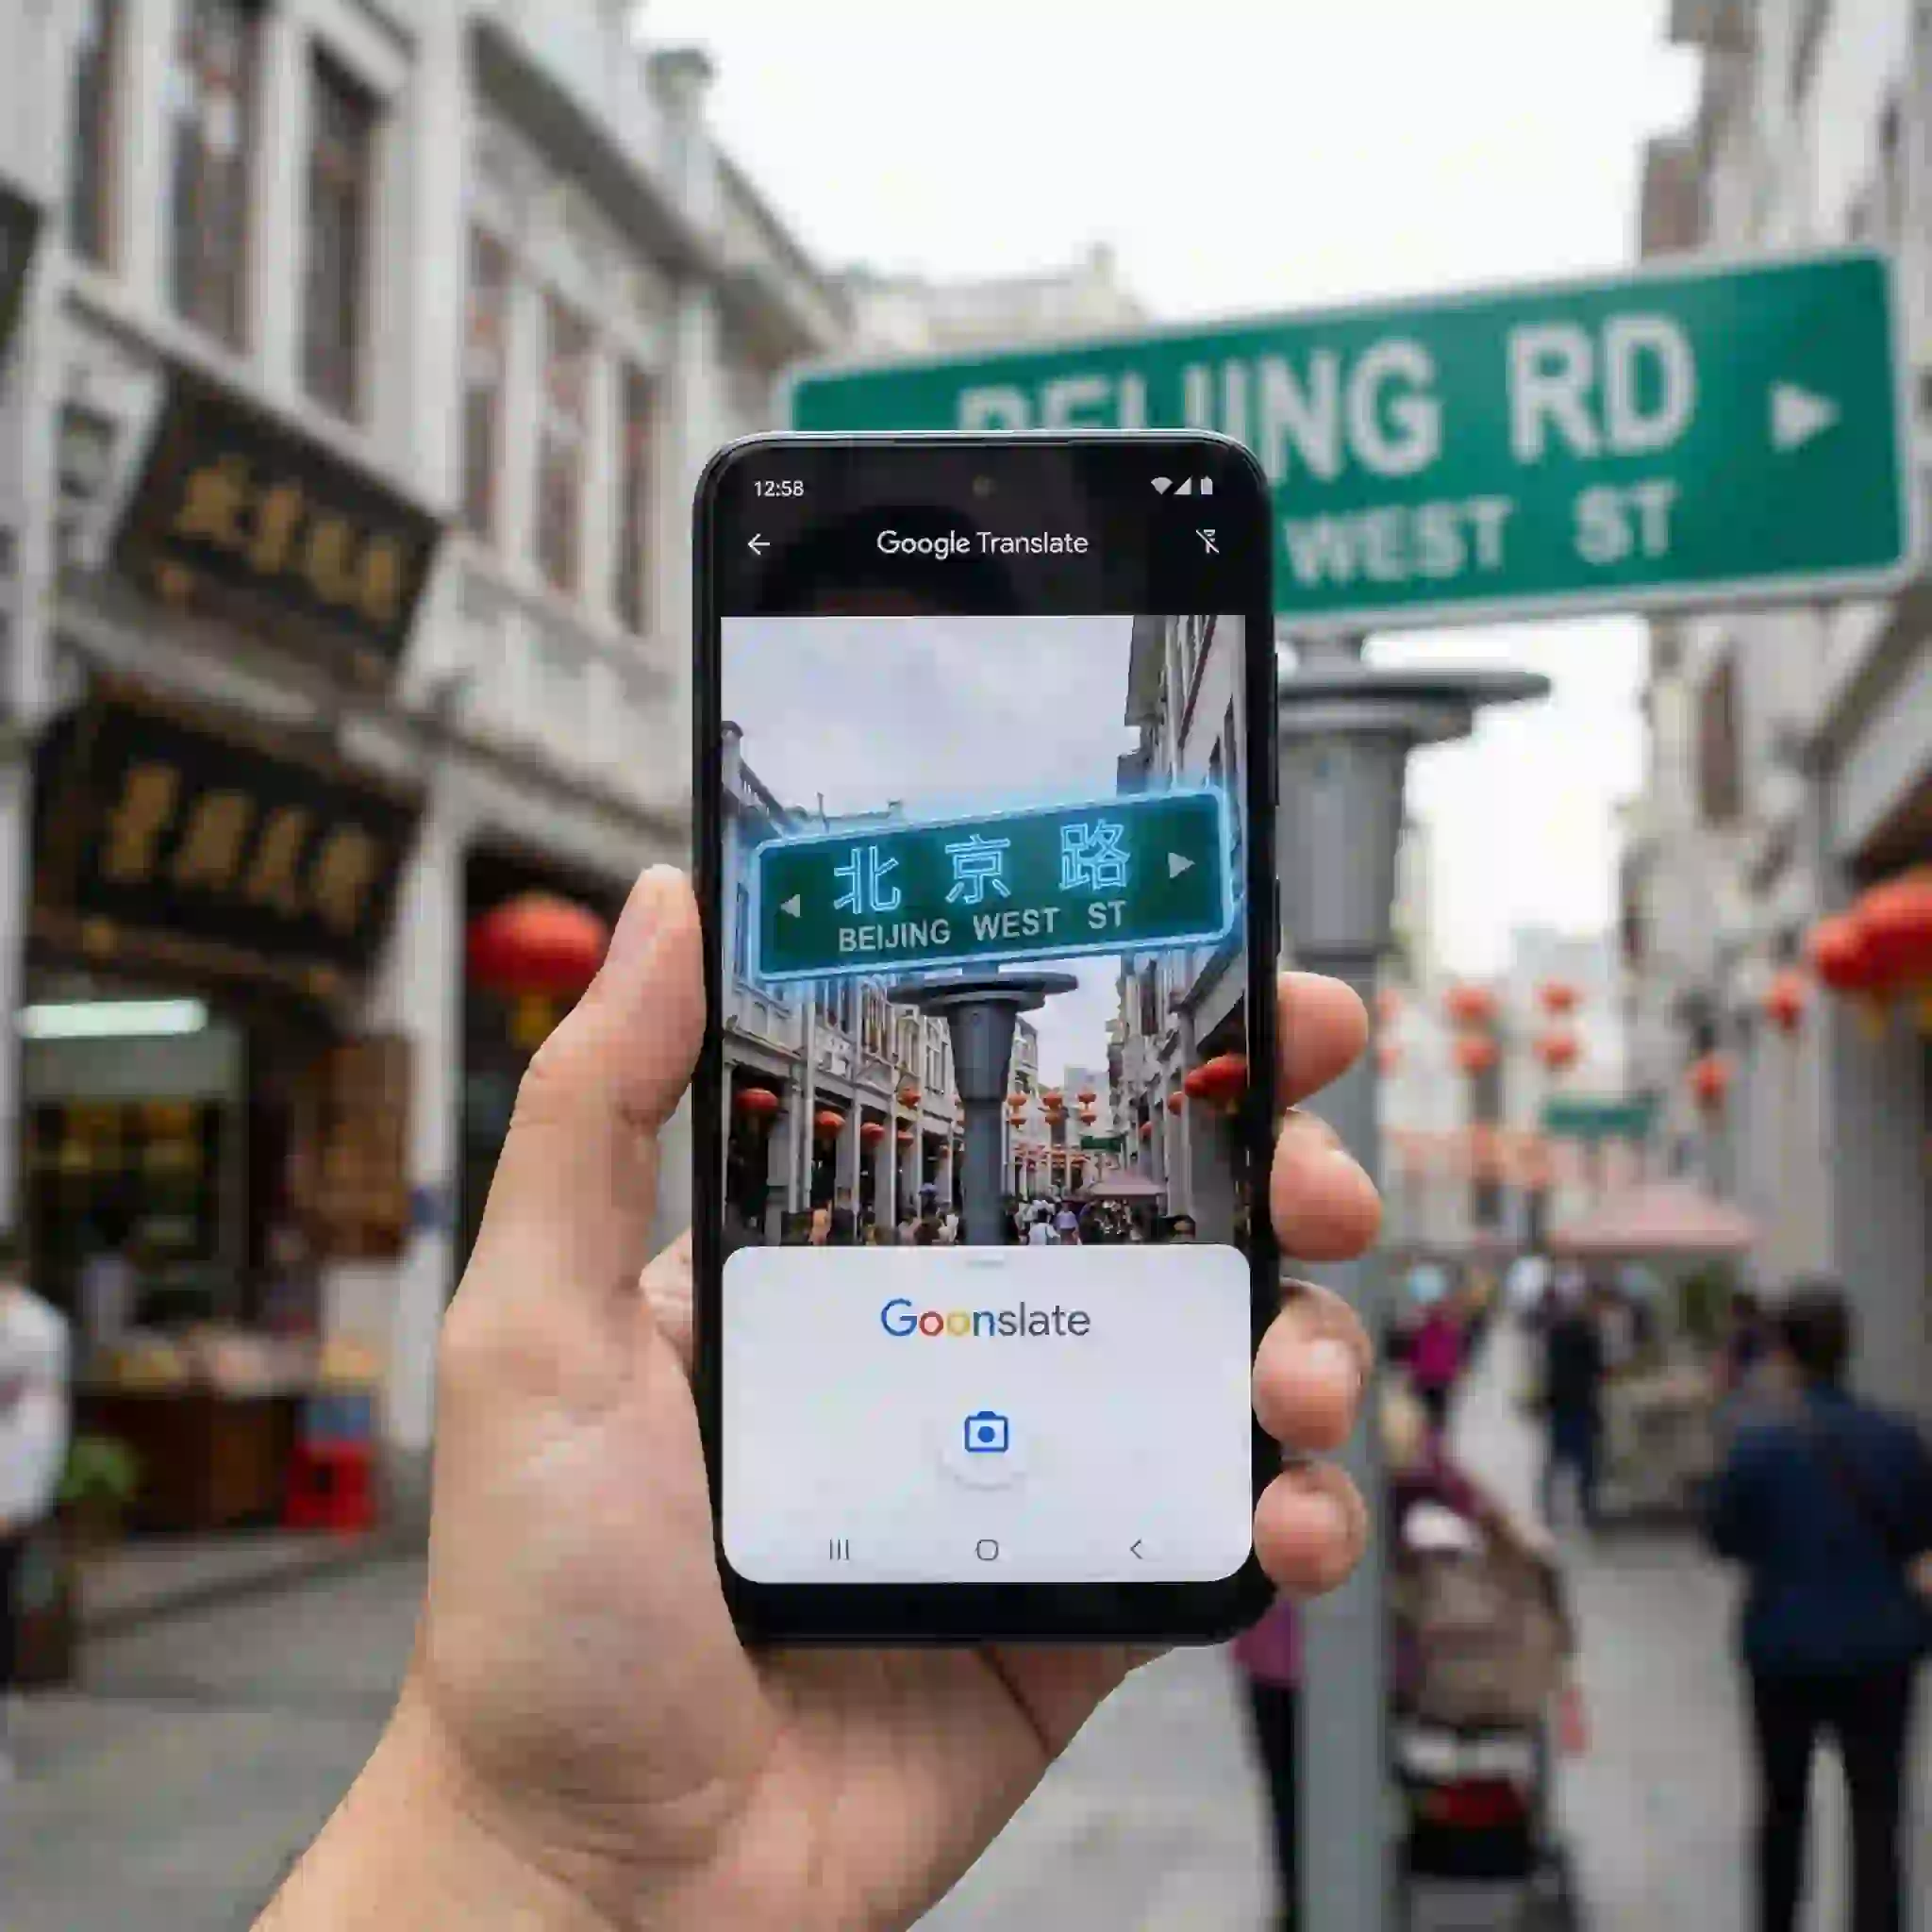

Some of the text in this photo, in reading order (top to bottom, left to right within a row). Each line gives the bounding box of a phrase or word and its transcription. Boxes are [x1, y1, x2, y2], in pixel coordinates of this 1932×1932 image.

[1508, 314, 1696, 463] RD
[754, 479, 804, 498] 12:58
[876, 529, 1090, 560] Google Translate
[1286, 480, 1675, 584] WEST ST
[833, 818, 1131, 915] 北京路
[839, 900, 1127, 953] BEIJING WEST ST
[881, 1298, 1091, 1338] Goonslate
